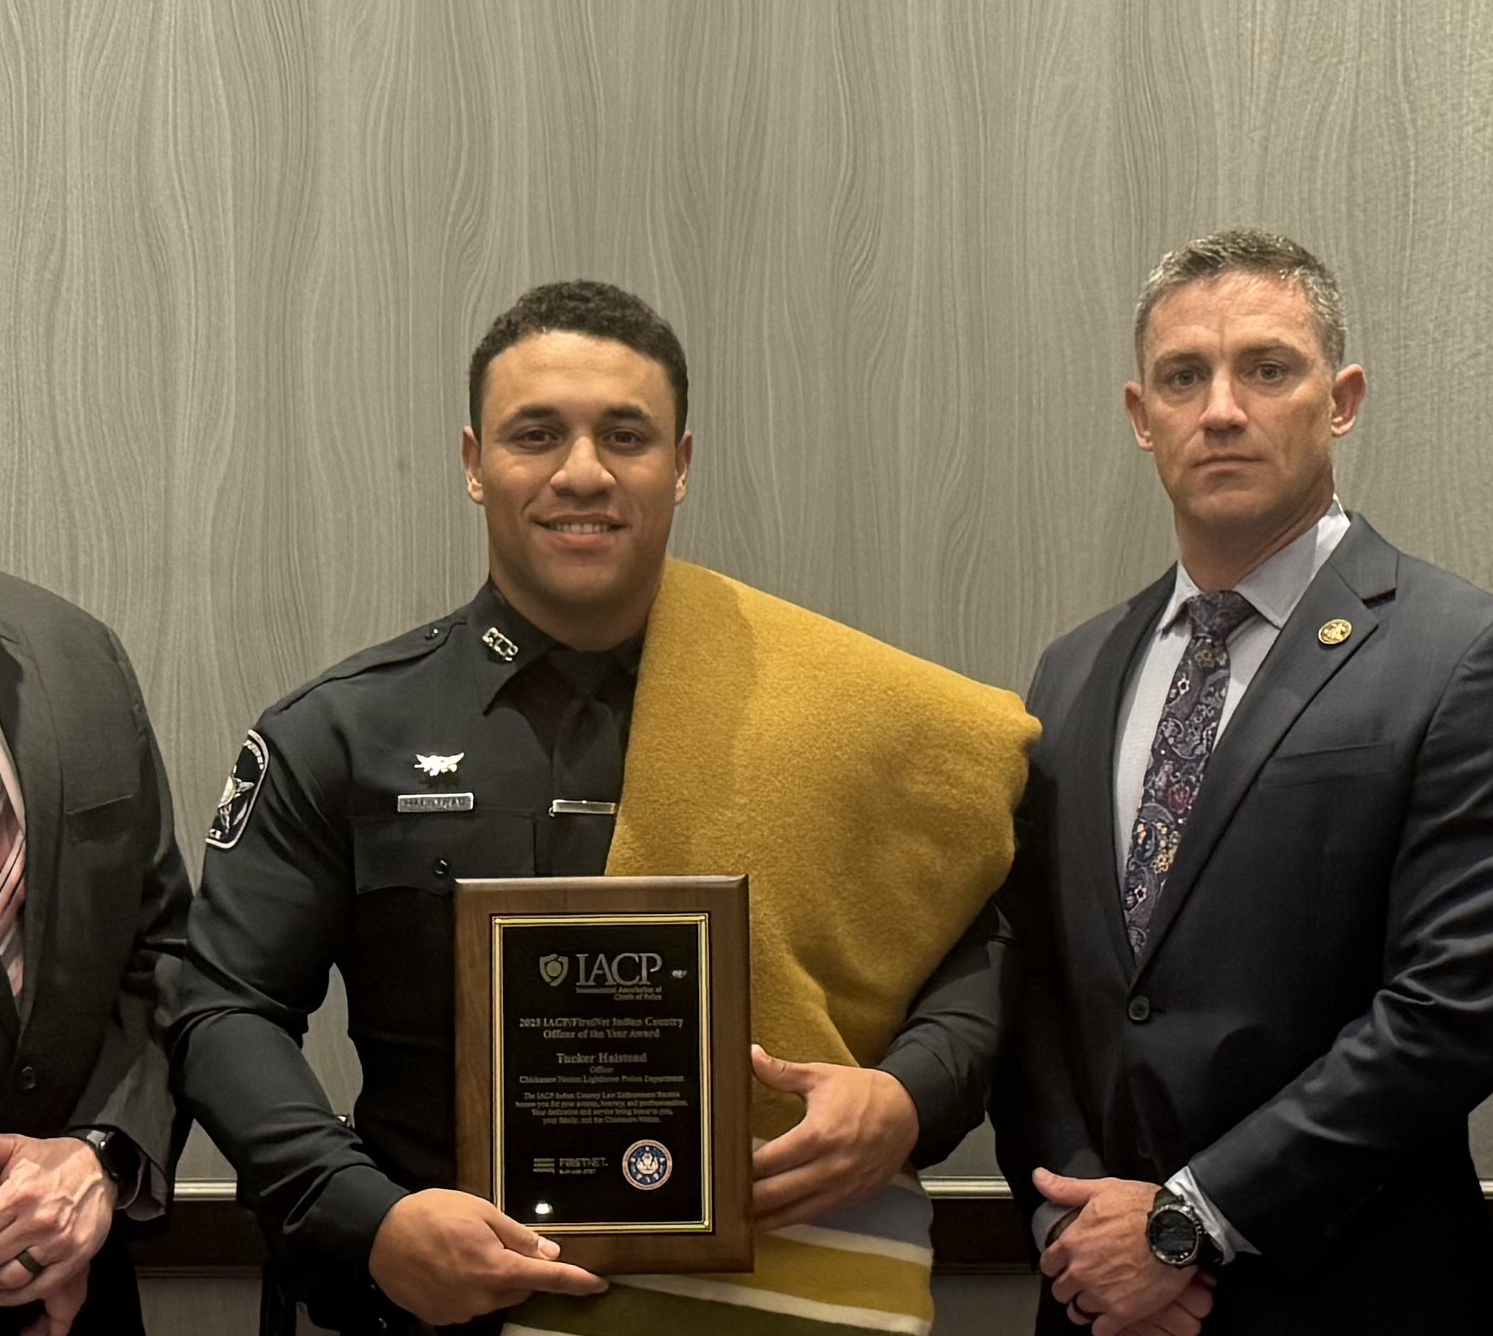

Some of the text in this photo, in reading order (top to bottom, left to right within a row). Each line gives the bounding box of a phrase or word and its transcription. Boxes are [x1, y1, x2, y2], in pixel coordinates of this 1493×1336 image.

[575, 952, 663, 986] IACP
[542, 1029, 576, 1039] Officer
[577, 1029, 588, 1038] of
[590, 1029, 605, 1038] the
[556, 1052, 596, 1064] Tucker
